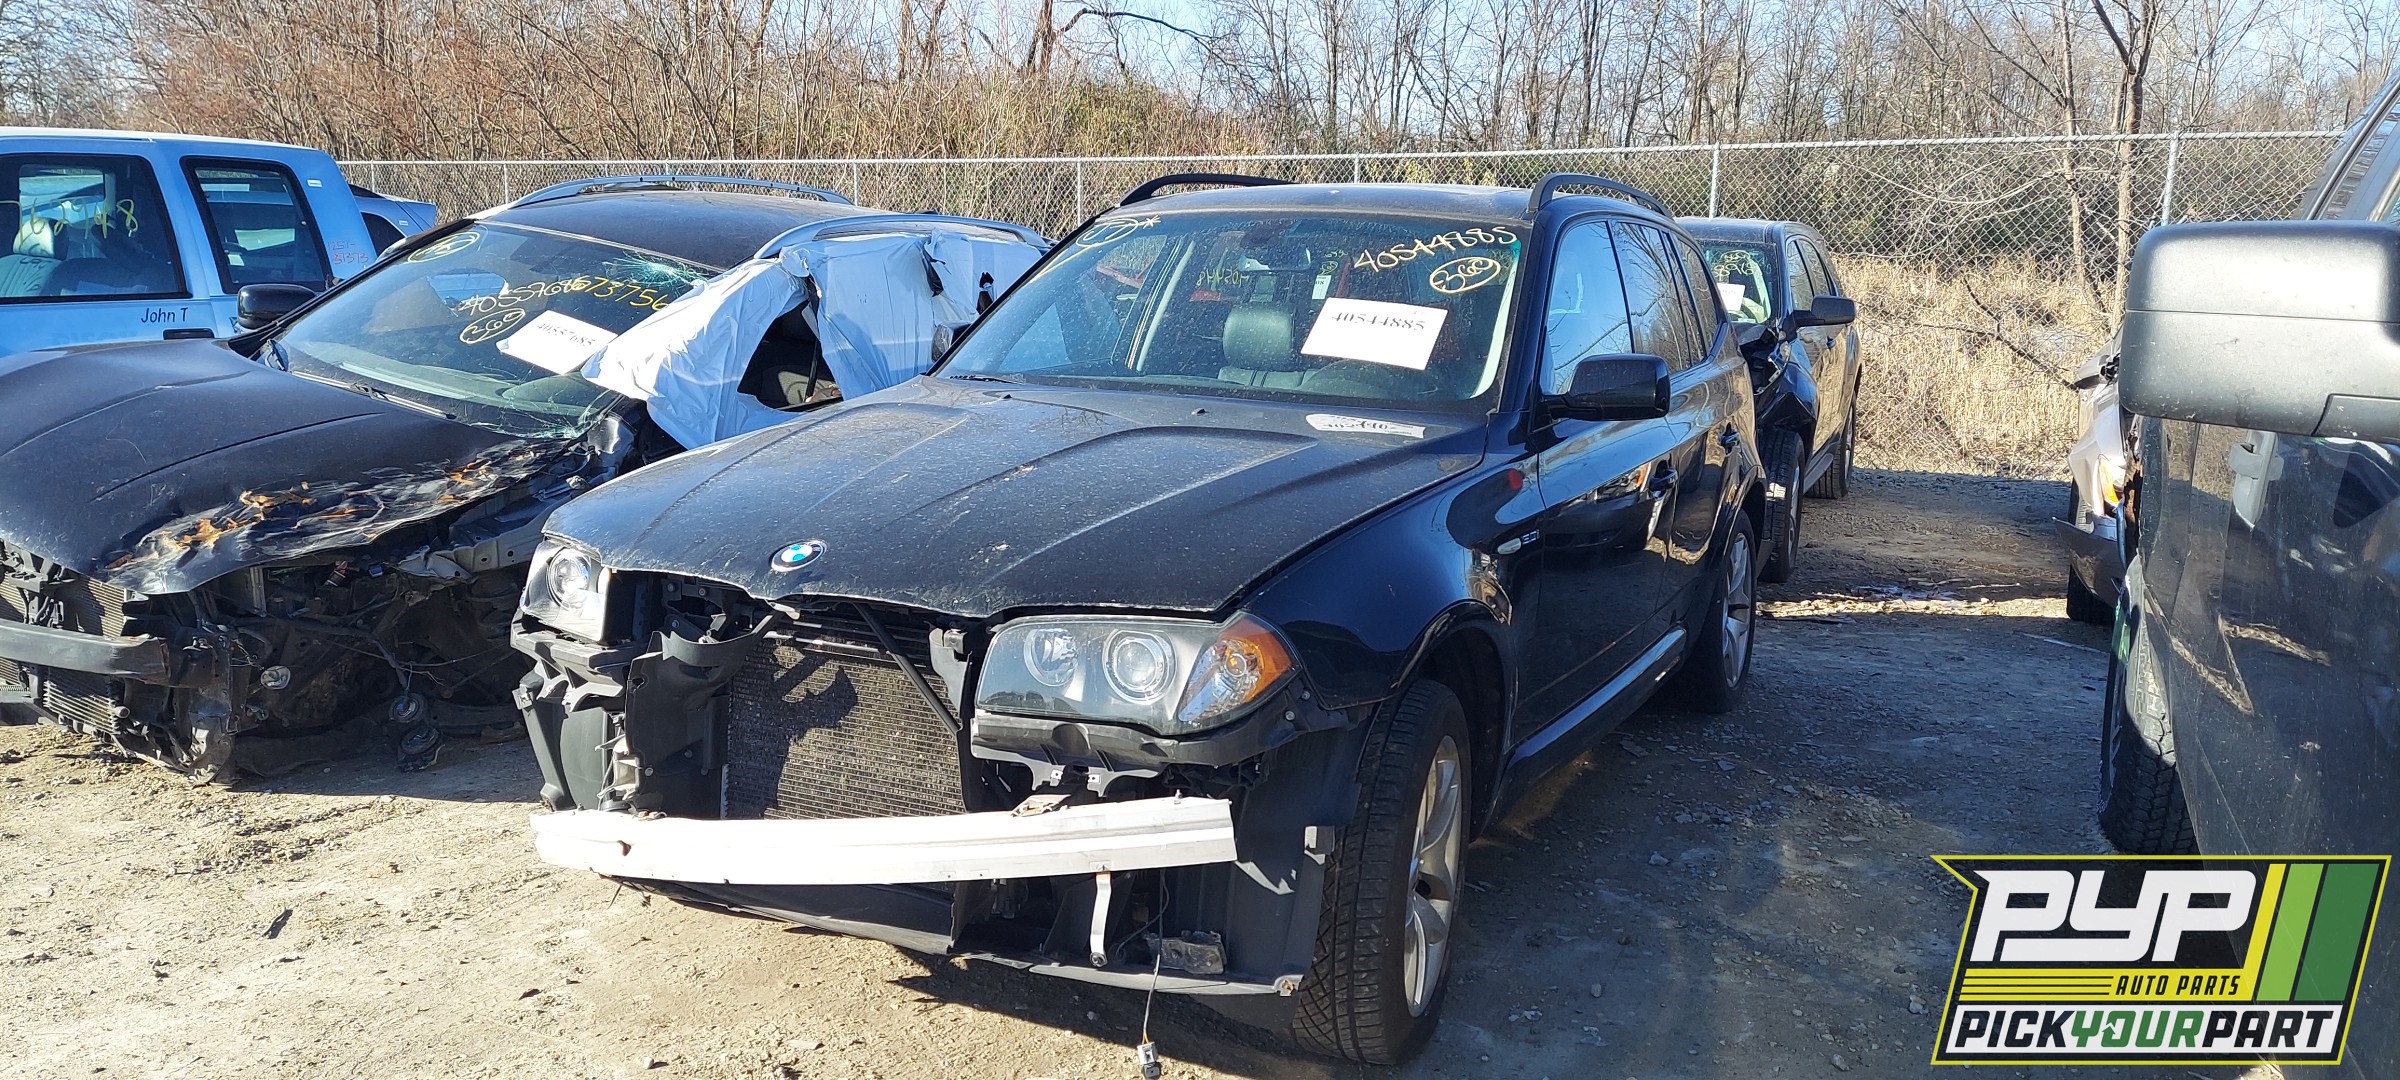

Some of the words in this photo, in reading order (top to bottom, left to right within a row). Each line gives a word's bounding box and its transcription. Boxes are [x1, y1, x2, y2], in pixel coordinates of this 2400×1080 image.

[1354, 226, 1518, 272] 40544885
[141, 307, 176, 323] John
[180, 307, 189, 322] T
[1331, 311, 1427, 331] 40544885
